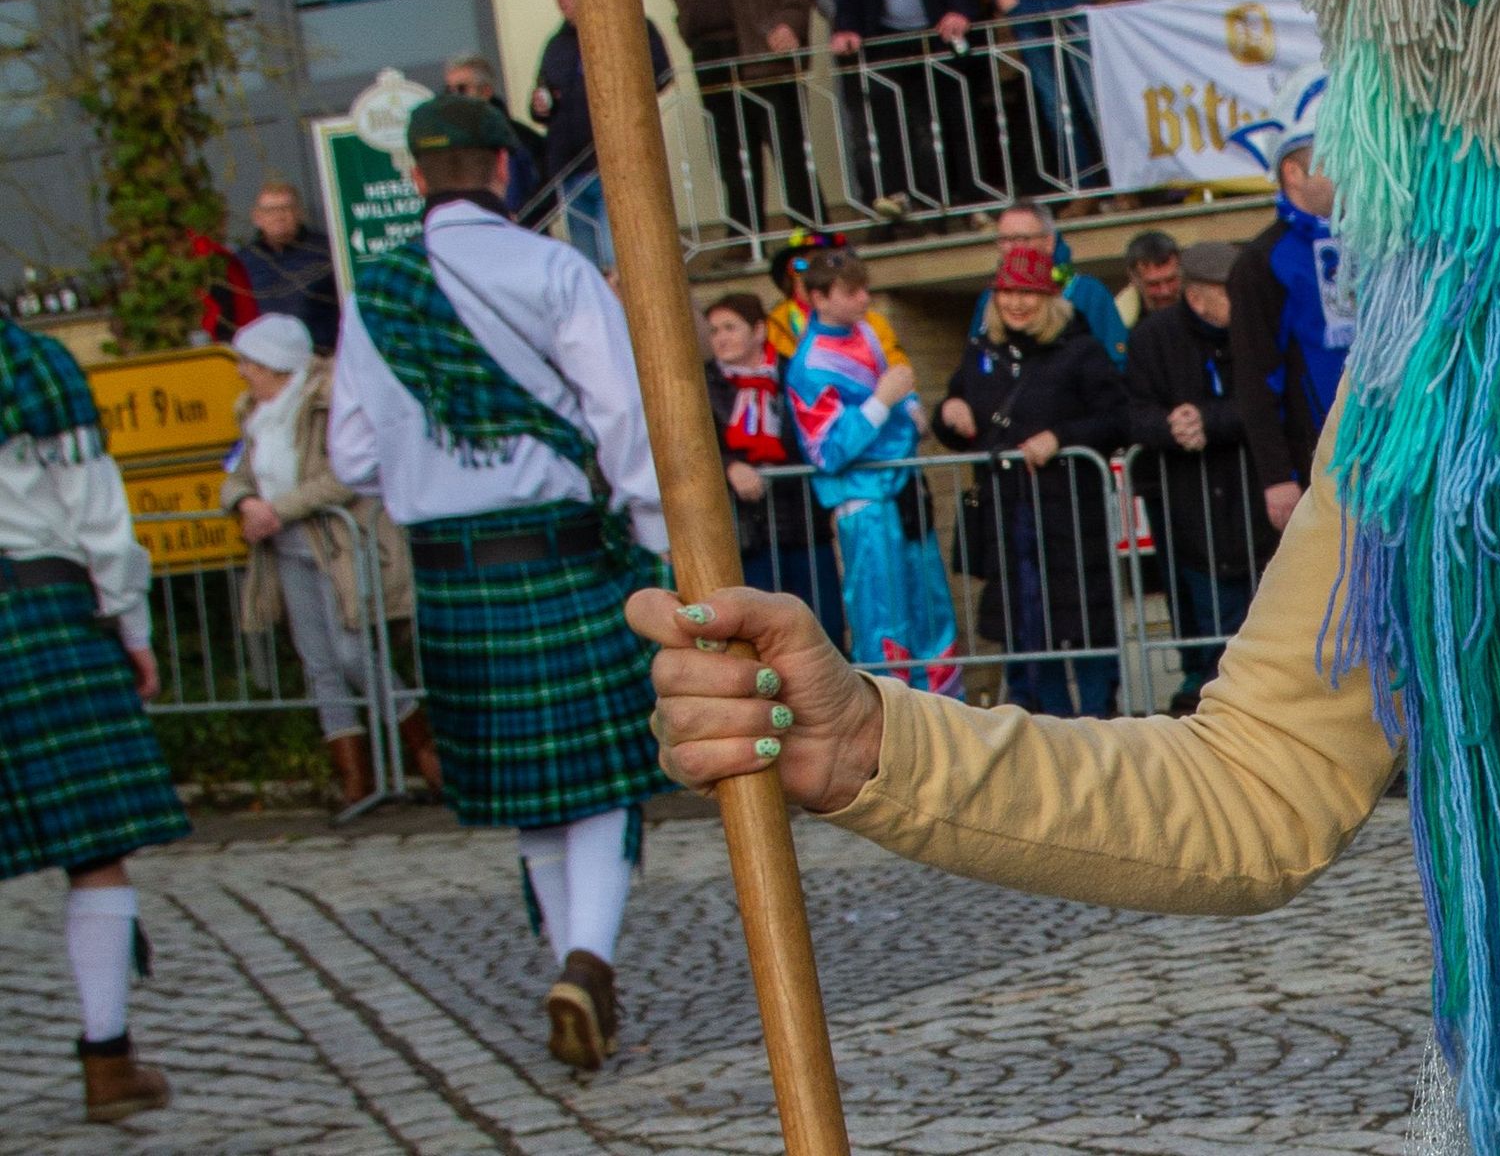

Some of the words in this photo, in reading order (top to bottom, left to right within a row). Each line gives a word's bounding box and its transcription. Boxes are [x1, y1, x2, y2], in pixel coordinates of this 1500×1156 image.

[1143, 79, 1269, 160] Bit
[351, 196, 426, 221] WILLKO
[152, 387, 170, 428] 9
